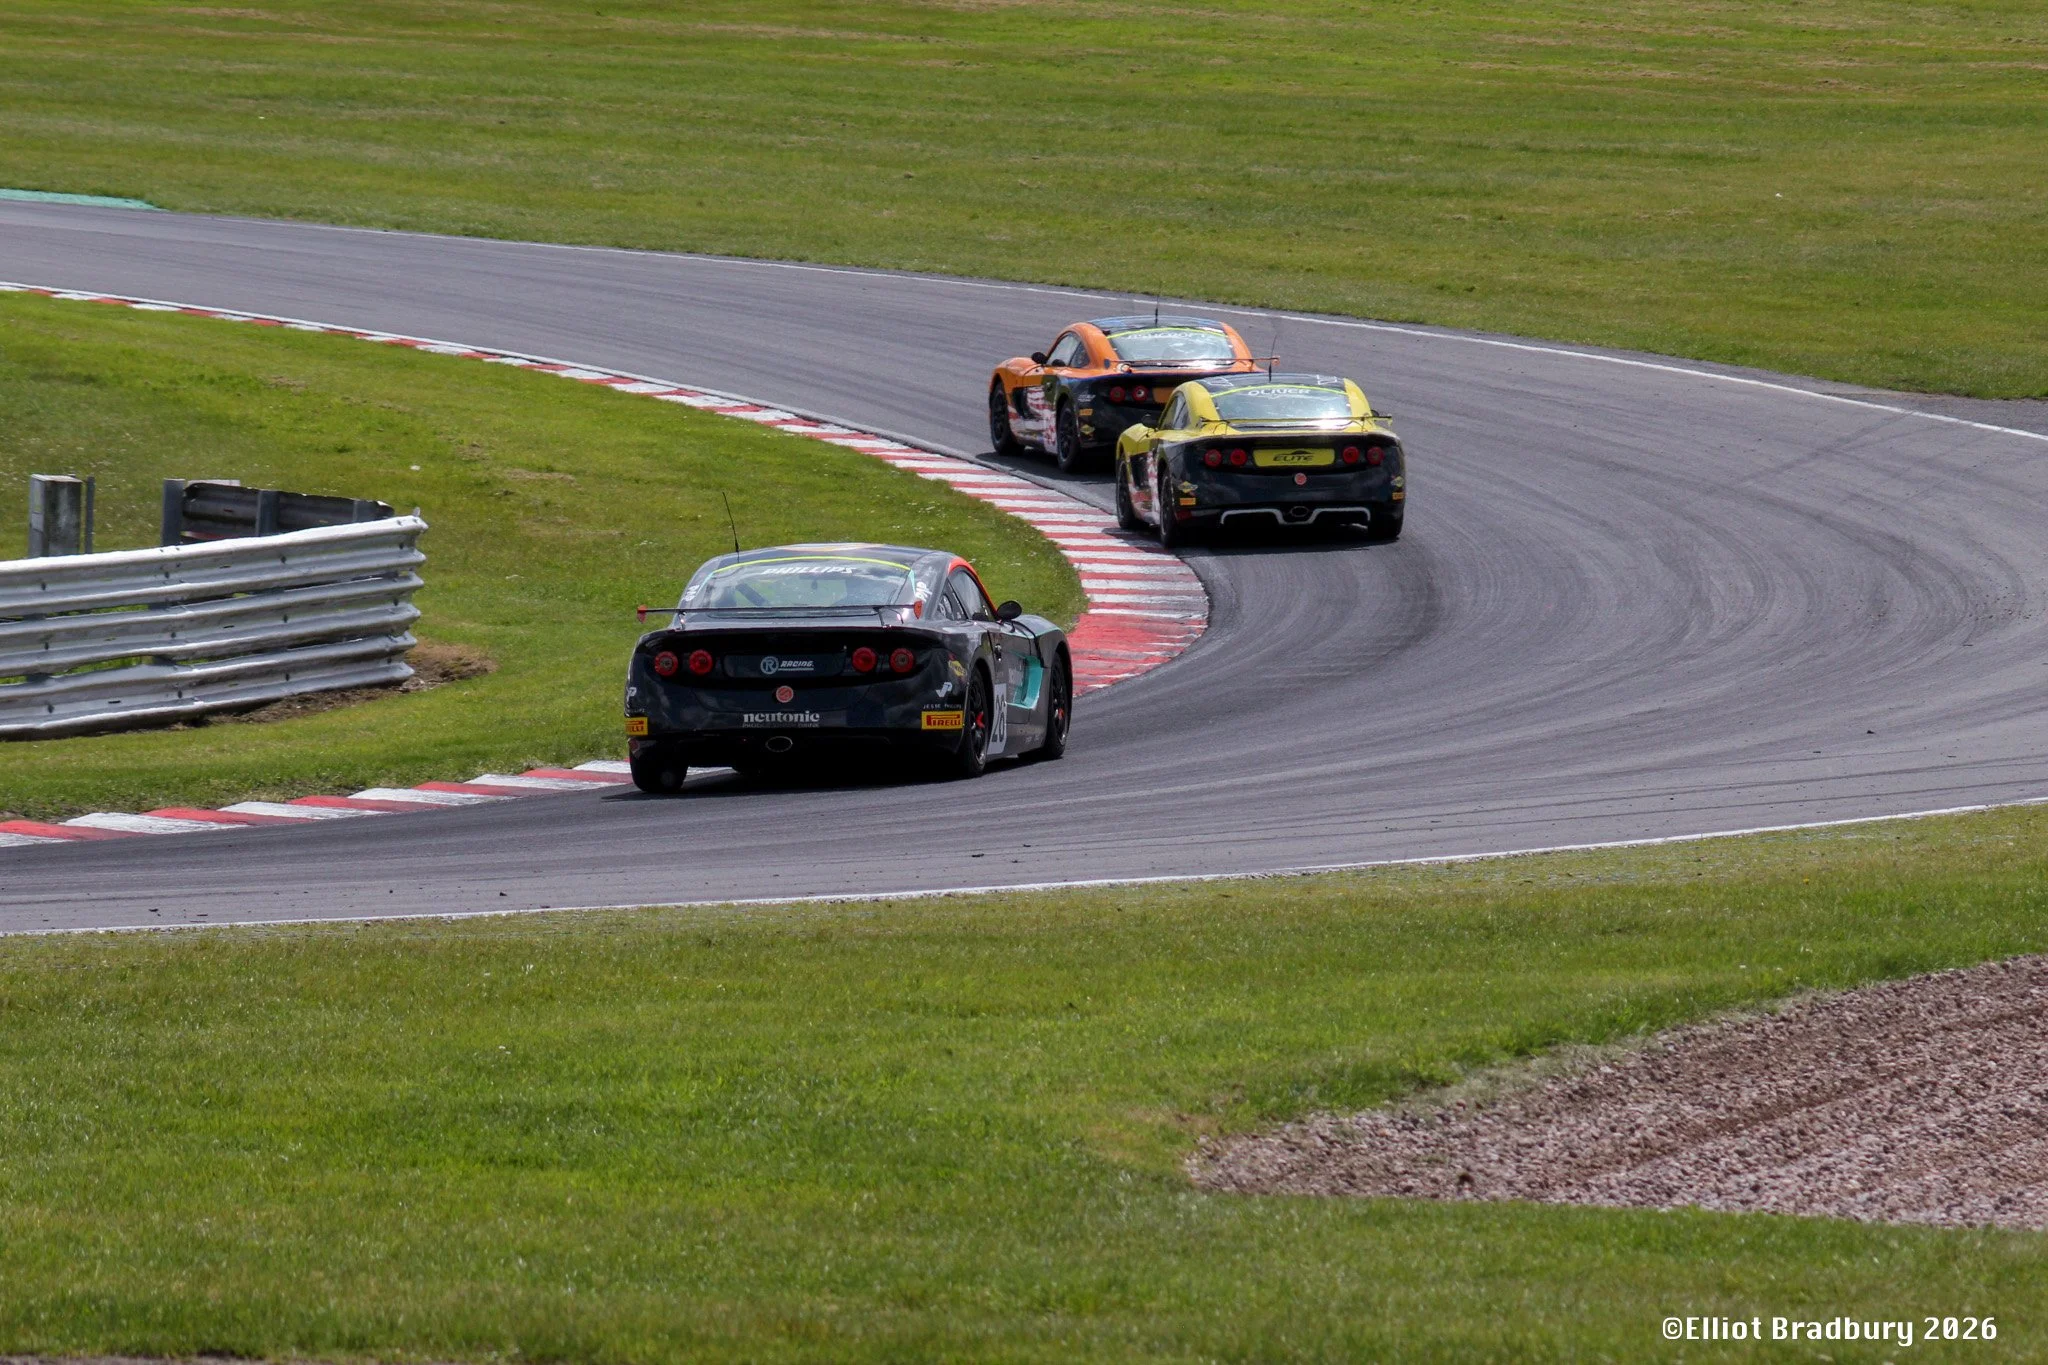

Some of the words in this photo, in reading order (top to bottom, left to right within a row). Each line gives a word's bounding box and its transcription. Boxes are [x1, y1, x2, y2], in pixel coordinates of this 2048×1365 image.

[1248, 388, 1311, 397] OLIVER
[761, 566, 857, 575] PHILLIPS
[742, 710, 821, 723] neutonic
[926, 714, 961, 727] PIRELLI
